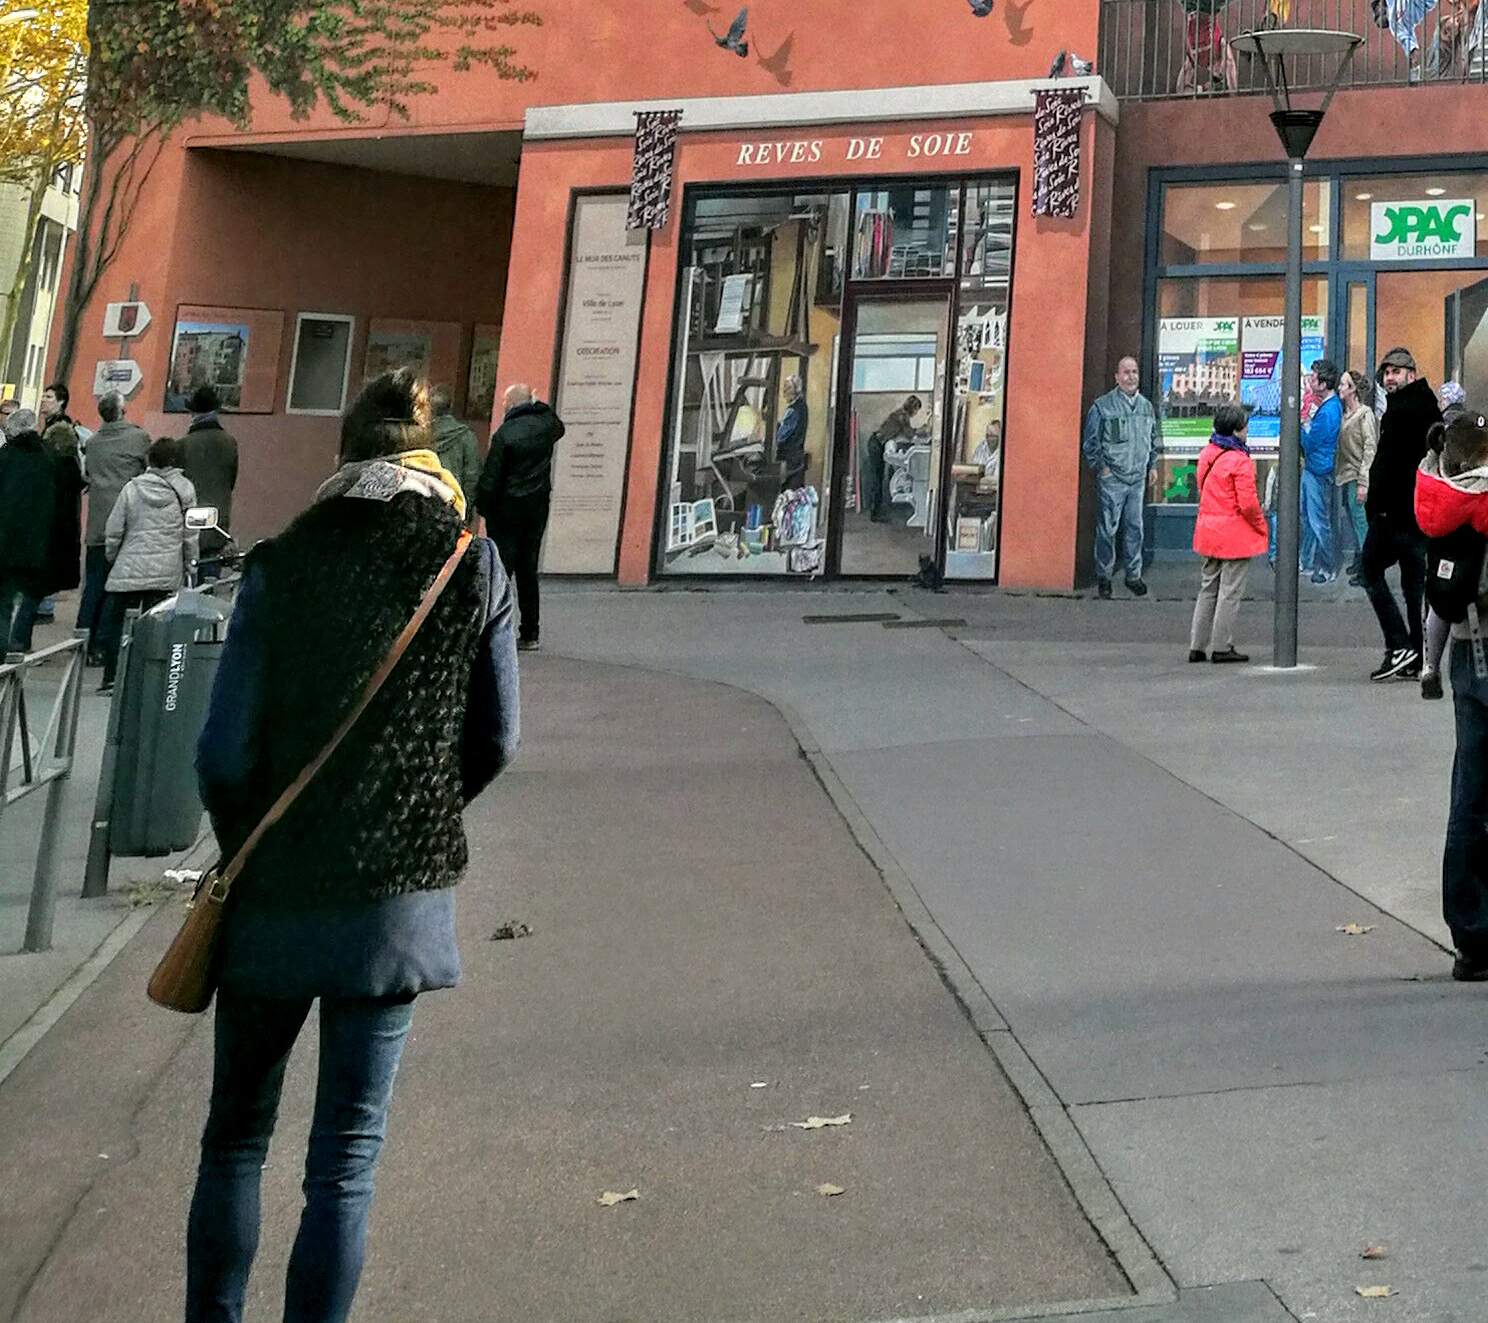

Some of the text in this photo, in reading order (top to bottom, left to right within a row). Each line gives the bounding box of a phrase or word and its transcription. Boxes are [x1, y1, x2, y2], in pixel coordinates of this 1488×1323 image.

[736, 132, 973, 165] REVES DE SOIE
[1254, 319, 1286, 328] VENDR
